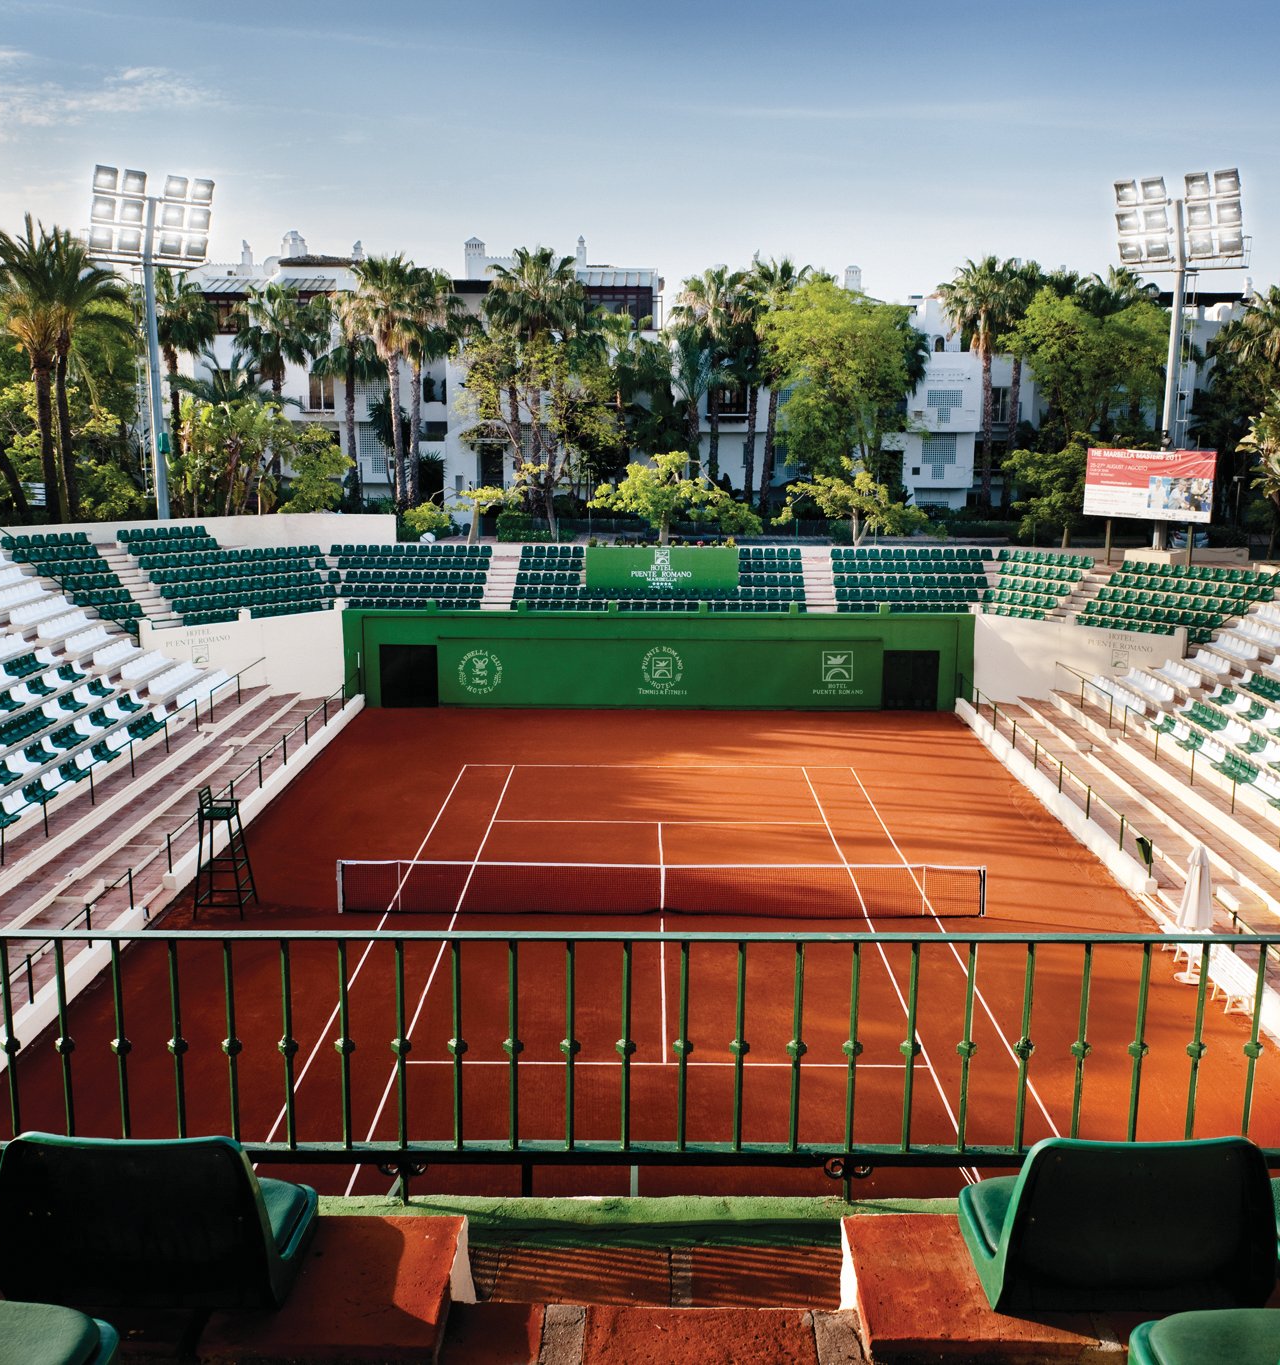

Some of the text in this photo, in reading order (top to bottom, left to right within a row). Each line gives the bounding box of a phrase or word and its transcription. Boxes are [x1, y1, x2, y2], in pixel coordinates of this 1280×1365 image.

[1091, 449, 1102, 457] THE
[1103, 450, 1135, 459] MARBELLA
[1136, 452, 1164, 460] MASTERS
[1165, 453, 1182, 461] 2011
[631, 570, 692, 578] PUENTE ROMANO
[186, 628, 210, 637] HOTEL
[1108, 632, 1135, 642] HOTEL
[165, 635, 231, 648] PUENTE ROMANO
[1119, 643, 1153, 653] ROMANO
[458, 649, 503, 671] MARBELLA CLUB
[641, 645, 684, 670] PUENTE ROMANO
[466, 685, 494, 694] HOTEL
[651, 680, 675, 689] HOTEL
